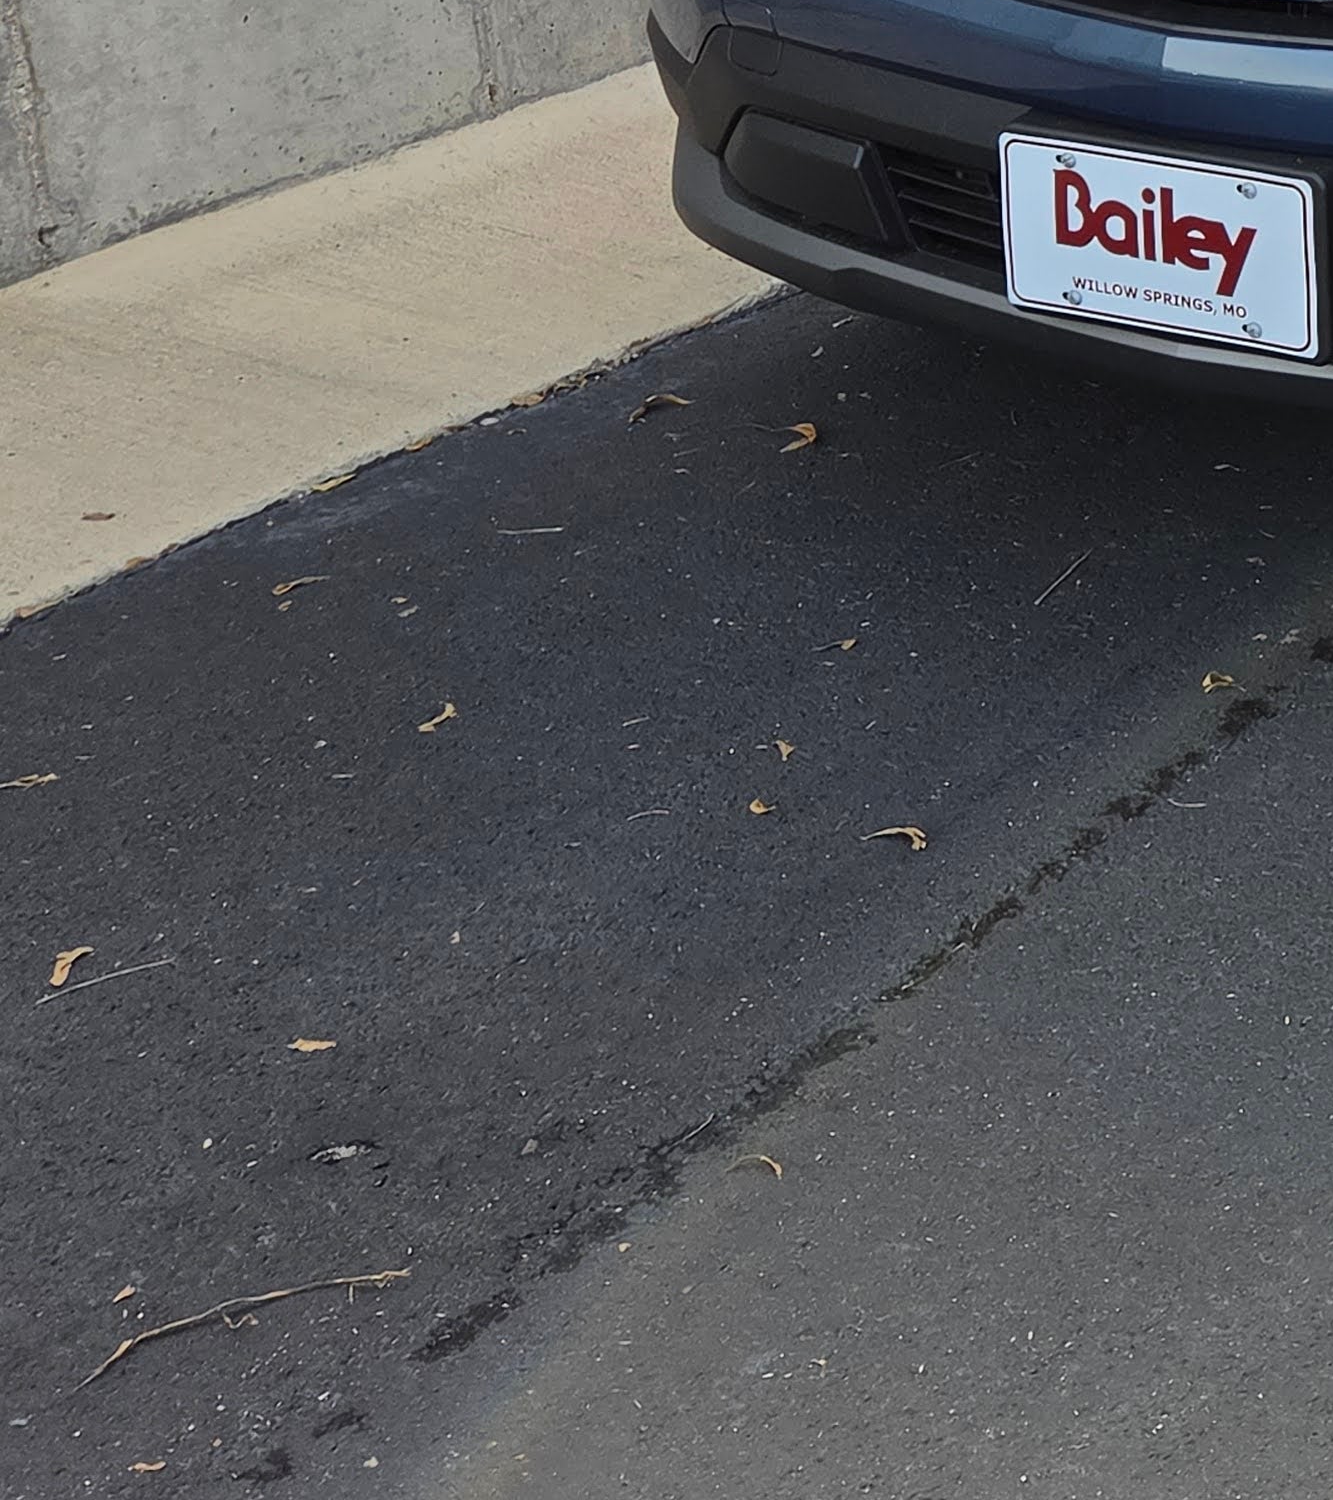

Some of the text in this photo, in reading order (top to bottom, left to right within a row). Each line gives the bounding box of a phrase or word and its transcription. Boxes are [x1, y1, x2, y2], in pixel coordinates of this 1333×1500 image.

[1054, 169, 1257, 297] Bailey
[1073, 277, 1247, 318] WILLOW SPRINGS, MO
